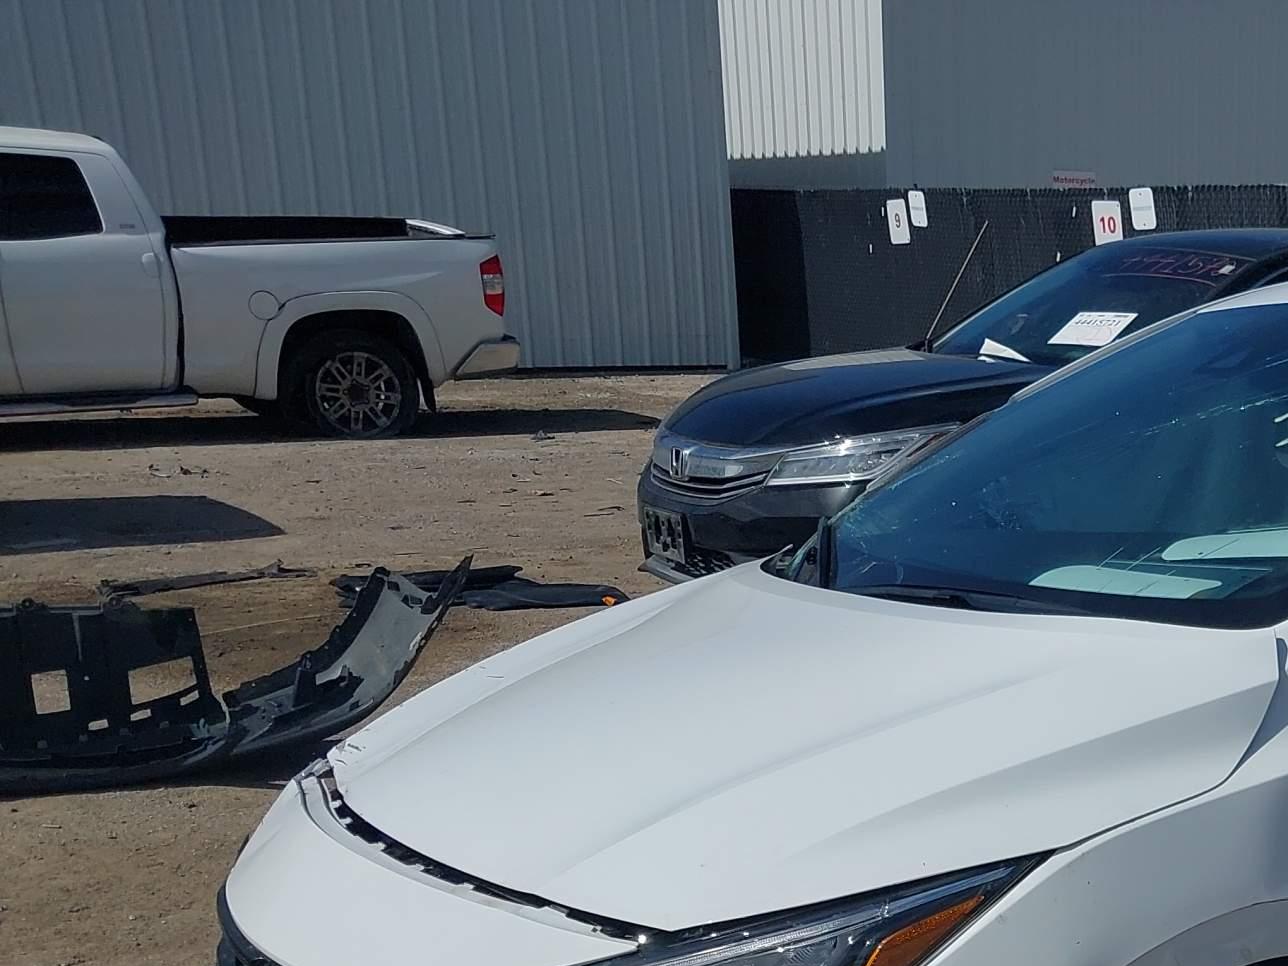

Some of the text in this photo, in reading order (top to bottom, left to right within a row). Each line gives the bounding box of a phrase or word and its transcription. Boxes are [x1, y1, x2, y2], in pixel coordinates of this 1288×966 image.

[1053, 174, 1095, 186] Motorcycle
[894, 212, 901, 229] 9
[1099, 215, 1117, 234] 10
